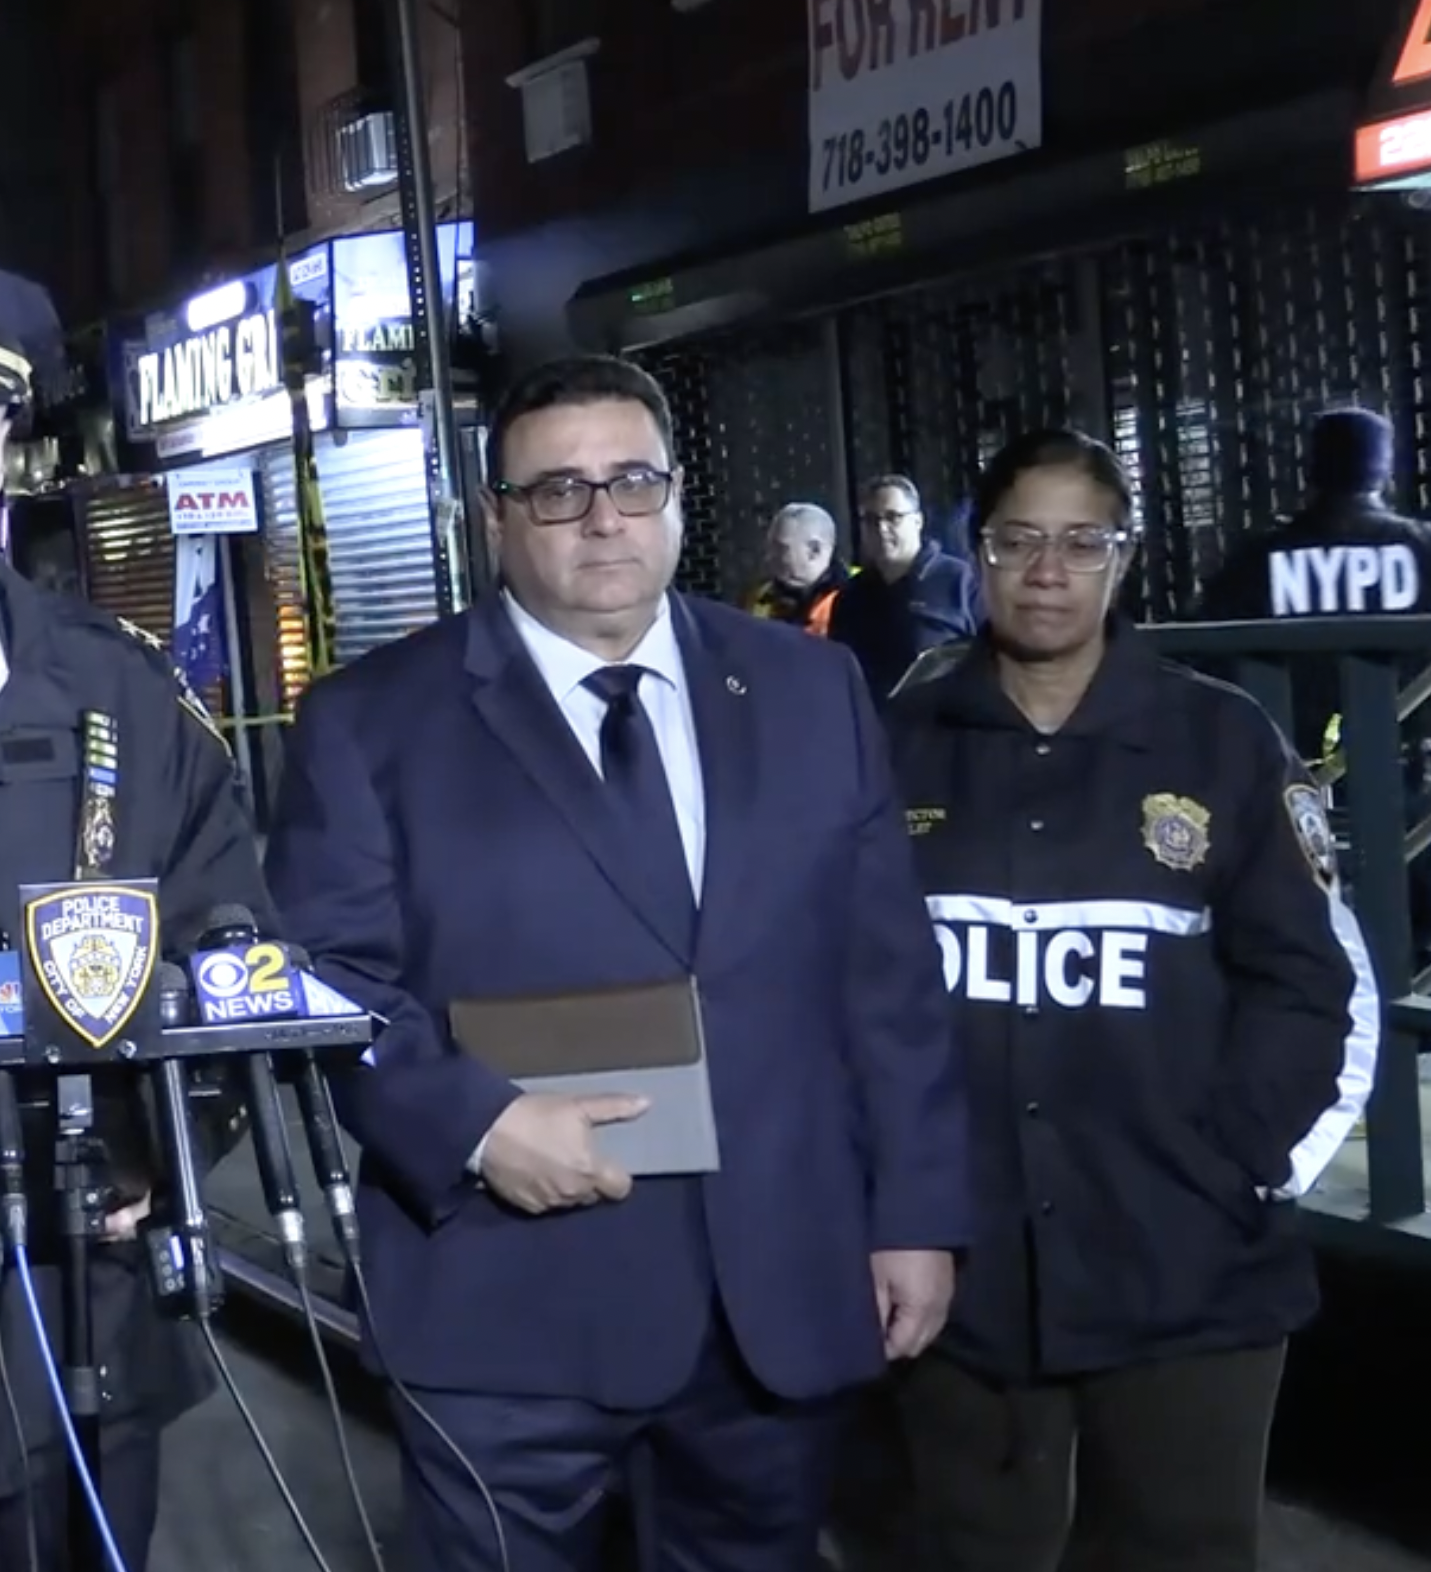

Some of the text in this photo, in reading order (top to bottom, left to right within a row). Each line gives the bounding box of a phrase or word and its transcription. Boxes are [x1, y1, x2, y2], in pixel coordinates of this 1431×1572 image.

[812, 0, 894, 91] FOR
[822, 80, 1016, 191] 718-398-1400
[138, 308, 278, 425] FLAMING GRI
[342, 324, 416, 351] FLAMI
[174, 490, 249, 511] ATM
[1270, 545, 1418, 615] NYPD
[41, 911, 144, 940] DEPARTMENT
[62, 896, 120, 917] POLICE
[43, 960, 86, 1019] CITY OF
[104, 946, 148, 1025] NEW YORK
[244, 943, 289, 993] 2
[933, 924, 1148, 1009] LICE
[205, 990, 294, 1021] NEWS
